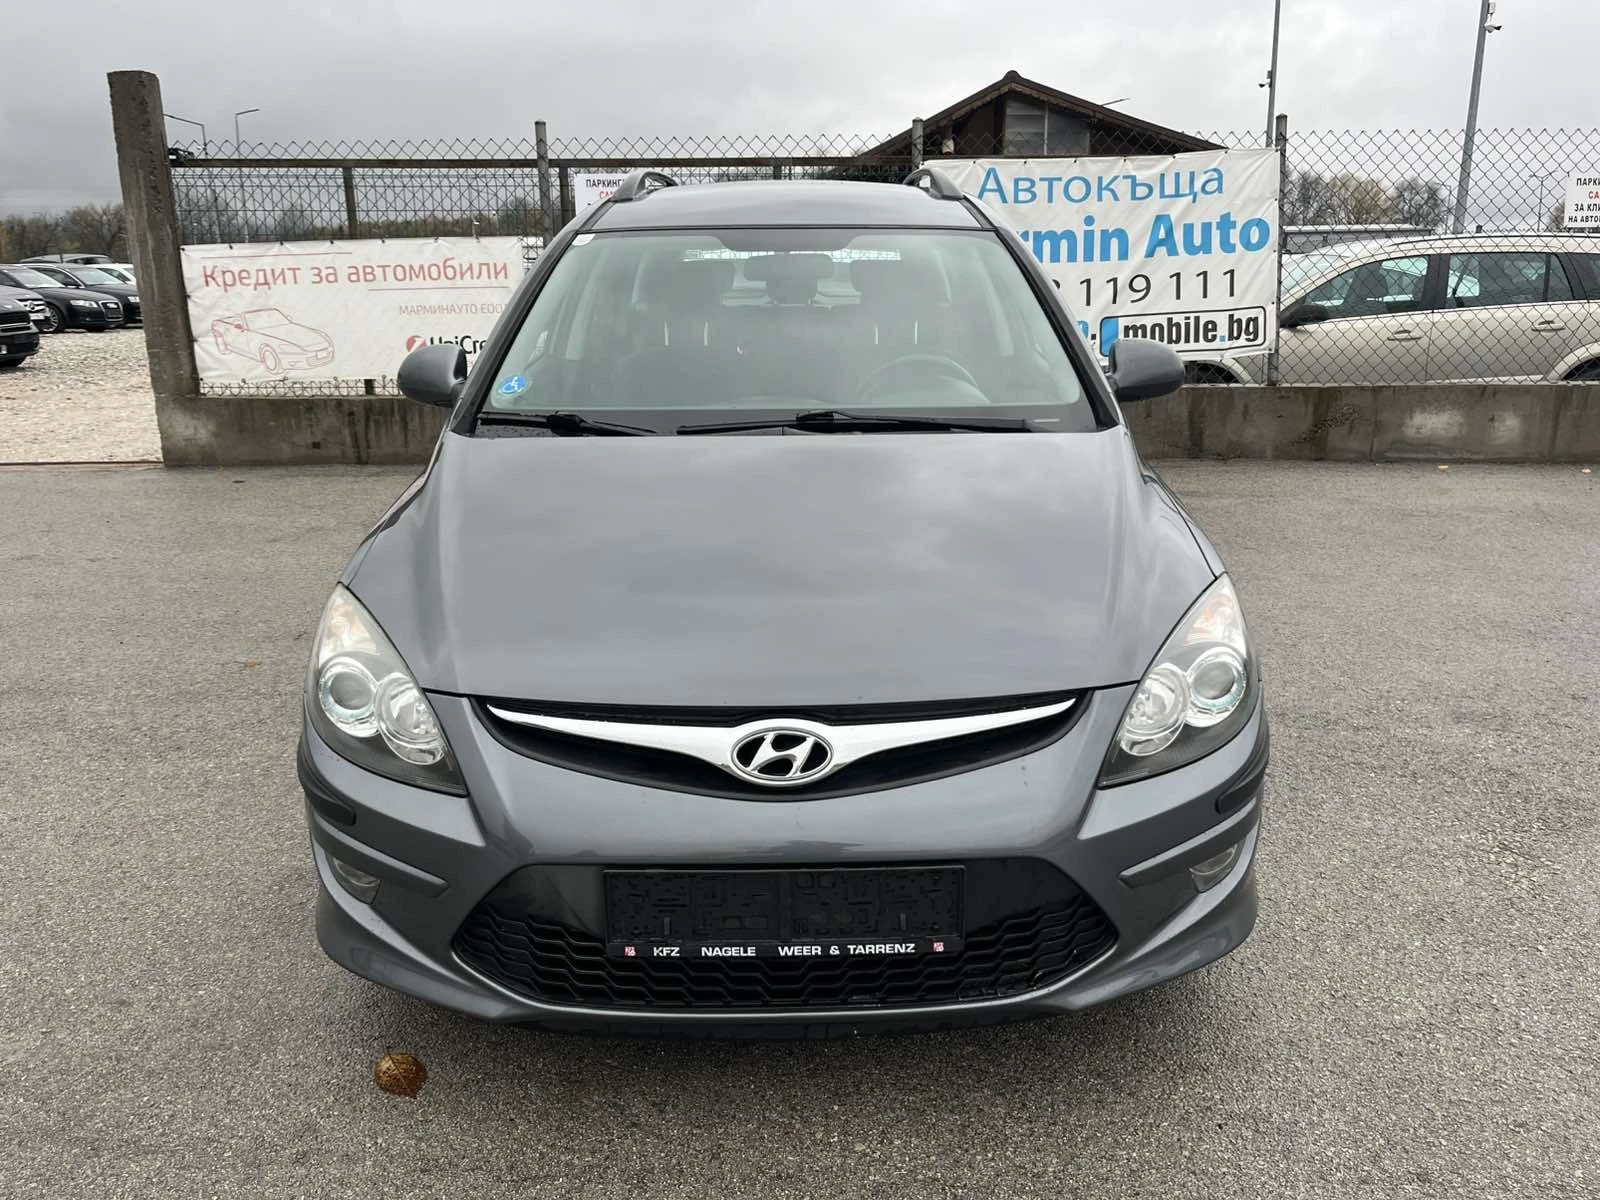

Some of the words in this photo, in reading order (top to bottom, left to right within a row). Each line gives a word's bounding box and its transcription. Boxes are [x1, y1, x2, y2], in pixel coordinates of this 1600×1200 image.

[586, 179, 624, 187] ПАРКИНГ
[977, 167, 1224, 204] Автокъща
[1574, 203, 1584, 212] ЗА
[1580, 215, 1600, 223] АВТО
[1144, 211, 1271, 258] Auto
[203, 265, 302, 293] Кредит
[311, 265, 338, 285] за
[347, 257, 510, 284] автомобили
[1080, 274, 1152, 307] 119
[1169, 268, 1239, 301] 111
[1123, 313, 1259, 345] mobile.bg
[653, 946, 680, 957] KFZ
[701, 946, 757, 957] NAGELE
[778, 945, 822, 957] WEER
[829, 945, 840, 956] &
[847, 943, 916, 955] TARRENZ
